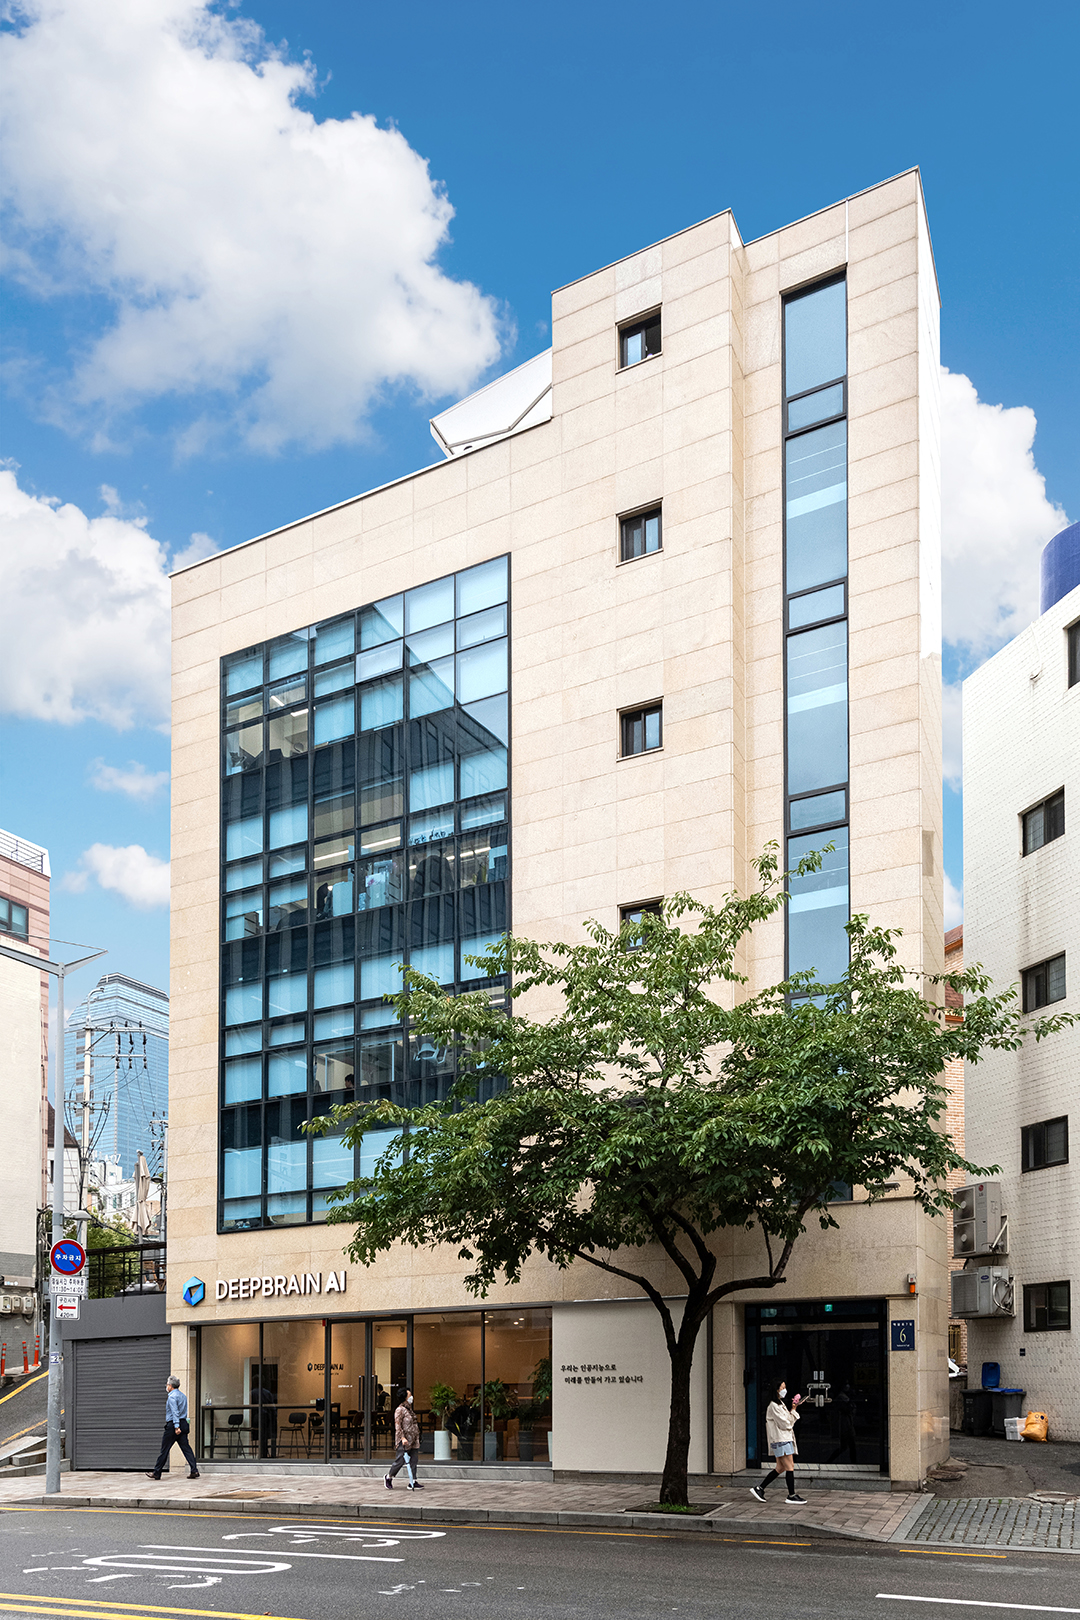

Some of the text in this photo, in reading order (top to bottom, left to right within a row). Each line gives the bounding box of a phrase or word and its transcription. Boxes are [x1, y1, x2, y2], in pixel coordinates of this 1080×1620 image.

[215, 1270, 347, 1300] DEEPBRAIN AI
[899, 1327, 907, 1343] 6
[560, 1364, 617, 1372] 우리는 인공지능으로
[564, 1375, 644, 1384] 미래를 만들어 가고 있습니다
